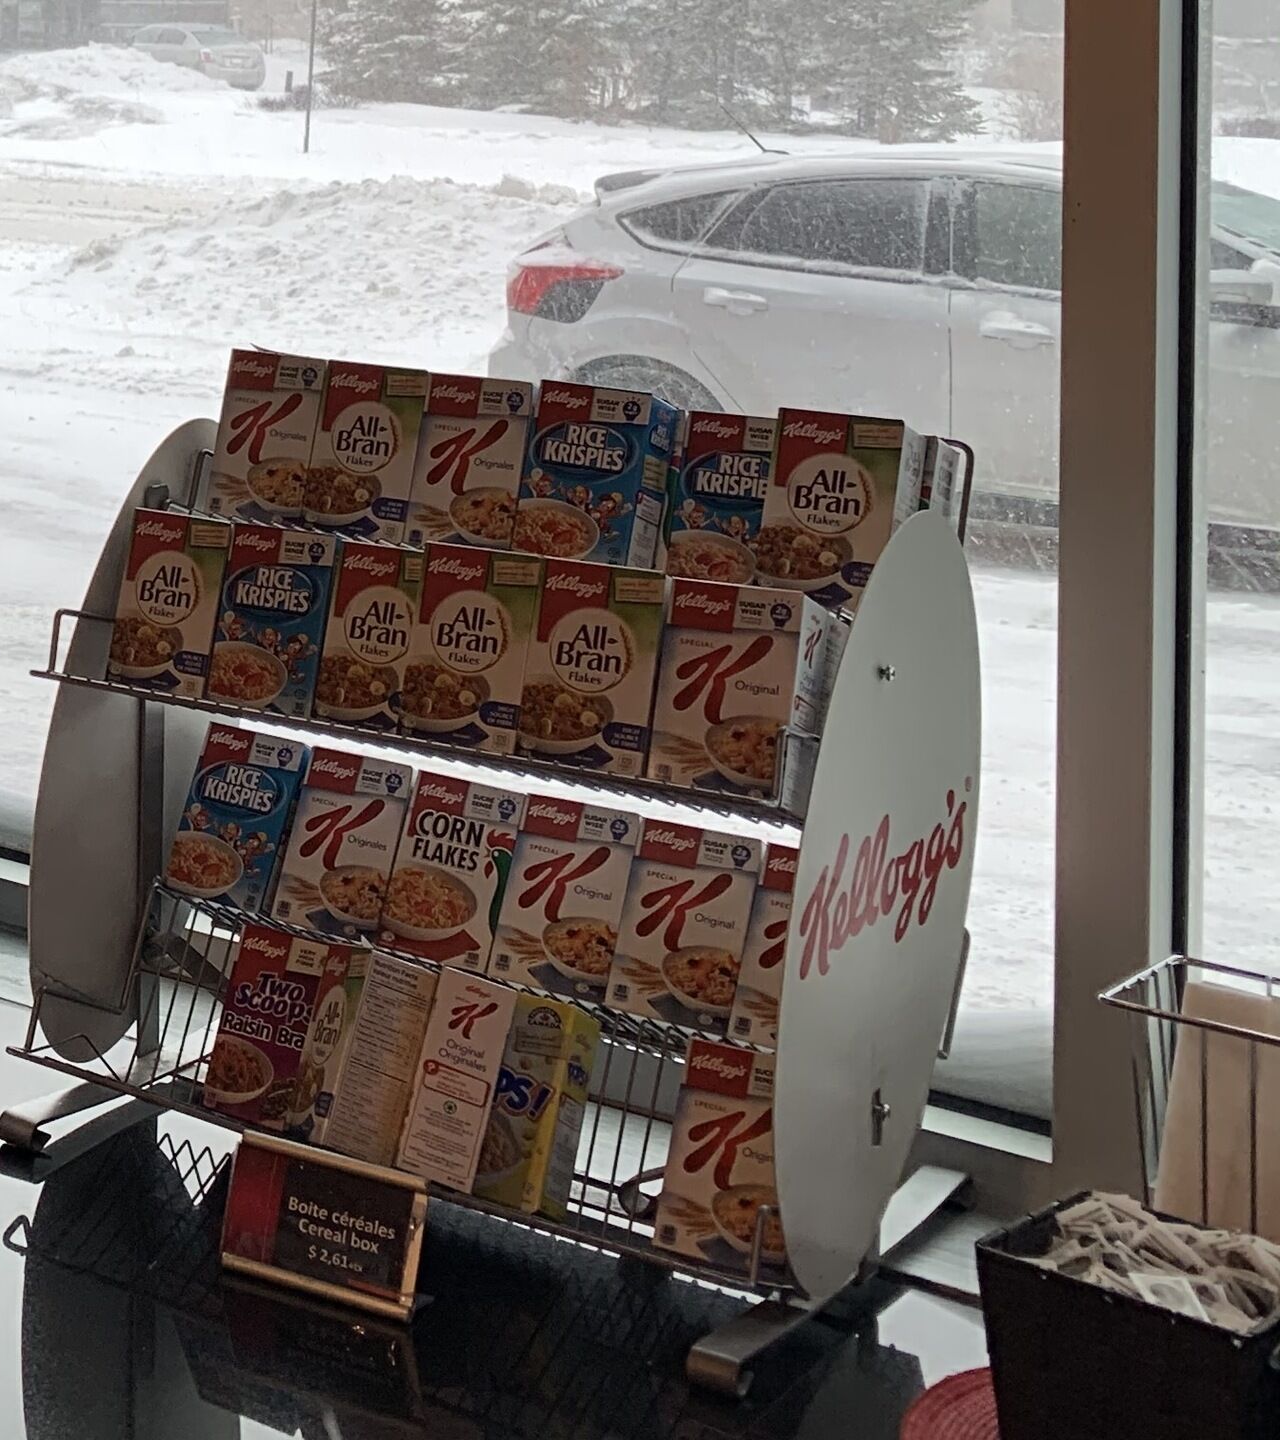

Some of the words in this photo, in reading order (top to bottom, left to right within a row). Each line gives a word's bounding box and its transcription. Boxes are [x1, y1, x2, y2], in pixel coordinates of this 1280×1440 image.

[330, 372, 379, 393] Kellogg's
[432, 385, 476, 406] Kellogg's
[543, 390, 588, 407] Kellogg's
[226, 392, 303, 465] K
[566, 424, 607, 446] RICE
[693, 419, 740, 438] Kellogg's
[783, 420, 845, 444] Kellogg's
[336, 430, 390, 457] Bran
[544, 440, 625, 473] KRISPIES
[426, 419, 509, 496] K
[719, 454, 762, 477] RICE
[697, 471, 768, 498] KRISPIE
[794, 485, 861, 517] Bran
[137, 521, 183, 543] Kellogg's
[807, 514, 841, 528] Flakes
[256, 567, 294, 590] RICE
[343, 554, 397, 577] Kellogg's
[429, 557, 484, 581] Kellogg's
[140, 580, 191, 609] Bran
[235, 582, 310, 613] KRISPIES
[545, 573, 605, 598] Kellogg's
[675, 592, 732, 615] Kellogg's
[349, 616, 407, 648] Bran
[436, 623, 498, 655] Bran
[679, 637, 714, 649] SPECIAL
[359, 644, 389, 657] Flakes
[448, 652, 481, 666] Flakes
[555, 641, 622, 674] Bran
[569, 671, 603, 685] Flakes
[672, 635, 774, 725] K
[225, 765, 262, 788] RICE
[312, 758, 356, 779] Kellogg's
[204, 778, 274, 812] KRISPIES
[419, 783, 464, 805] Kellogg's
[528, 803, 577, 825] Kellogg's
[299, 799, 385, 871] K
[418, 810, 485, 848] CORN
[645, 828, 696, 851] Kellogg's
[412, 838, 479, 871] FLAKES
[518, 846, 611, 924] K
[800, 790, 967, 980] Kellogg's
[635, 873, 733, 953] K
[220, 1011, 272, 1042] Raisin
[276, 1023, 306, 1051] Bra
[313, 1020, 338, 1048] Bran
[448, 1002, 498, 1040] K
[691, 1054, 747, 1079] Kellogg's
[496, 1065, 553, 1120] PS!
[288, 1195, 329, 1220] Boite
[331, 1210, 396, 1240] céréales
[298, 1218, 346, 1245] Cereal
[350, 1233, 380, 1254] box
[308, 1244, 317, 1260] $
